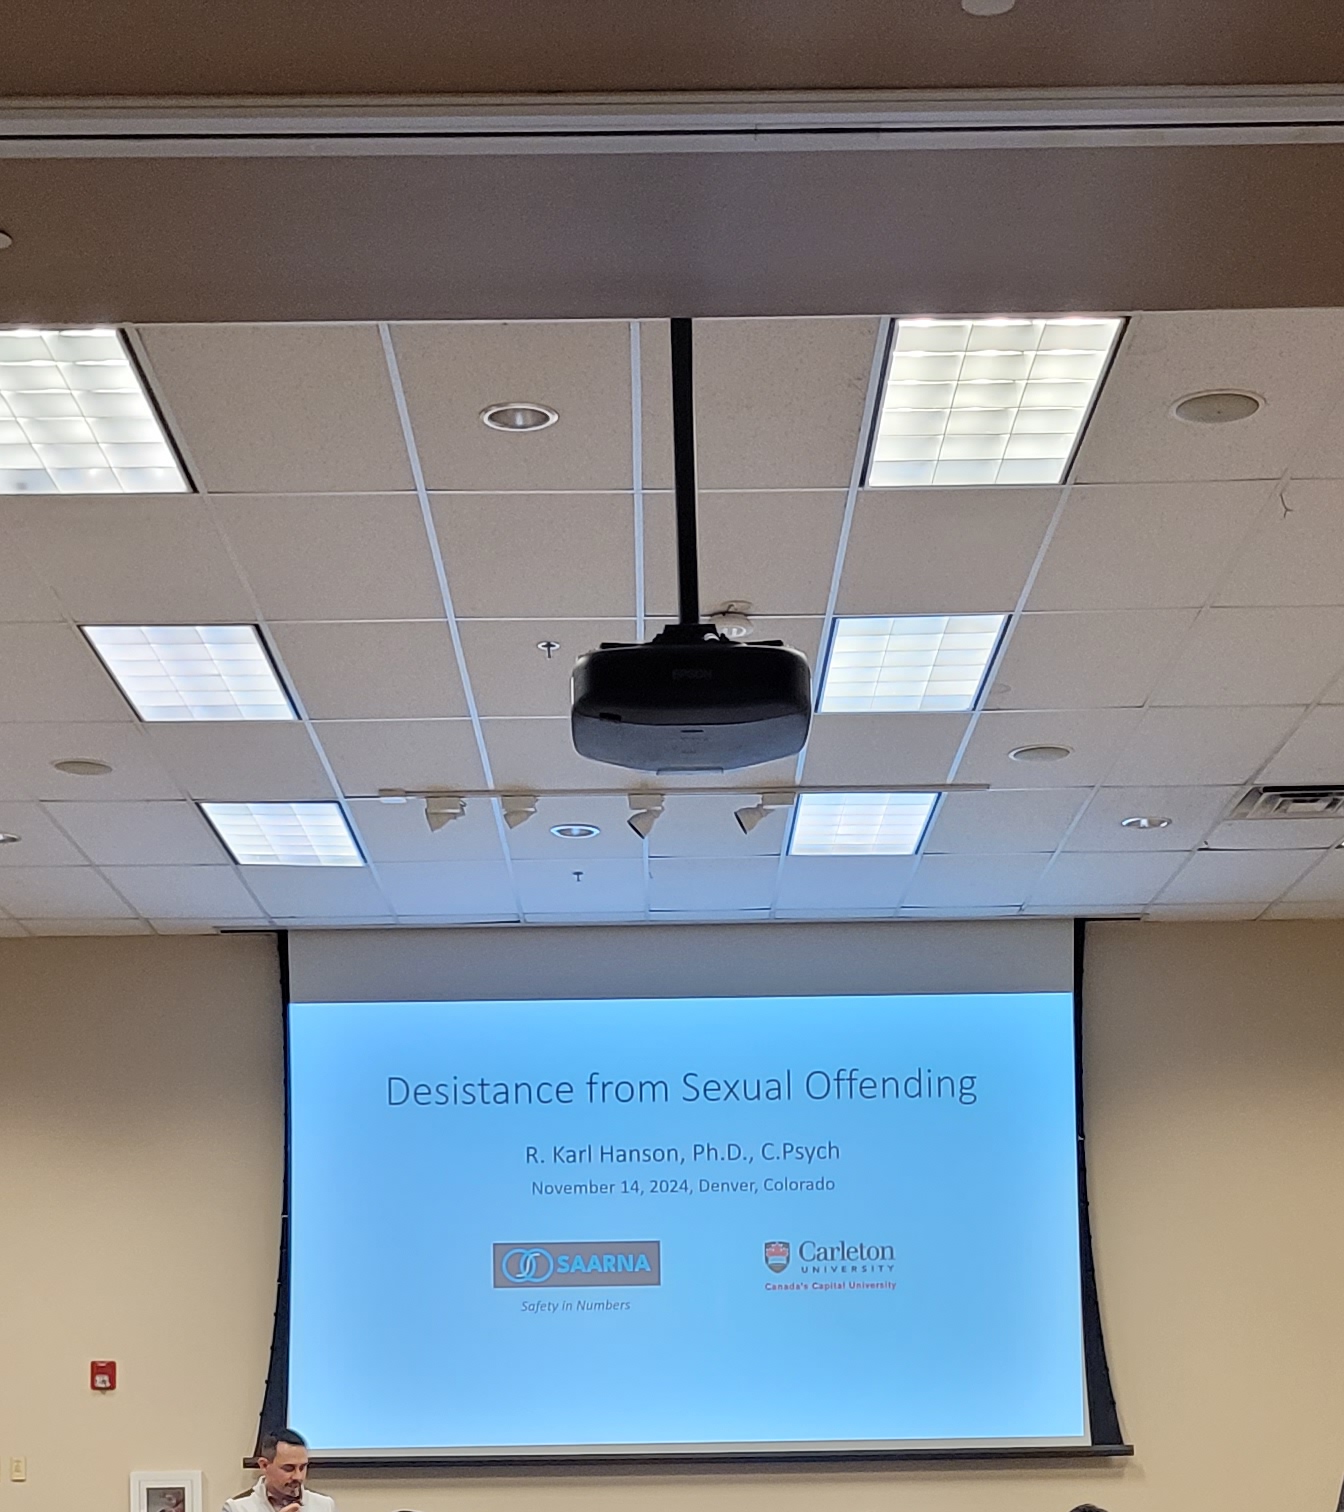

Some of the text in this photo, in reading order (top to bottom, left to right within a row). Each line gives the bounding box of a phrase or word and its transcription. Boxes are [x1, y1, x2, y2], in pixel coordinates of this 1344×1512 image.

[387, 1067, 977, 1106] Desistance from Sexual Offending
[525, 1141, 841, 1165] R. Karl Hanson, Ph.D., C.Psych
[532, 1177, 835, 1196] November 14, 2024, Denver, Colorado
[799, 1240, 896, 1262] Carleton
[557, 1254, 651, 1273] SAARNA
[801, 1265, 895, 1273] UNIVERSITY
[764, 1281, 897, 1291] Canada's Capital University
[521, 1299, 631, 1314] Safety in Numbers
